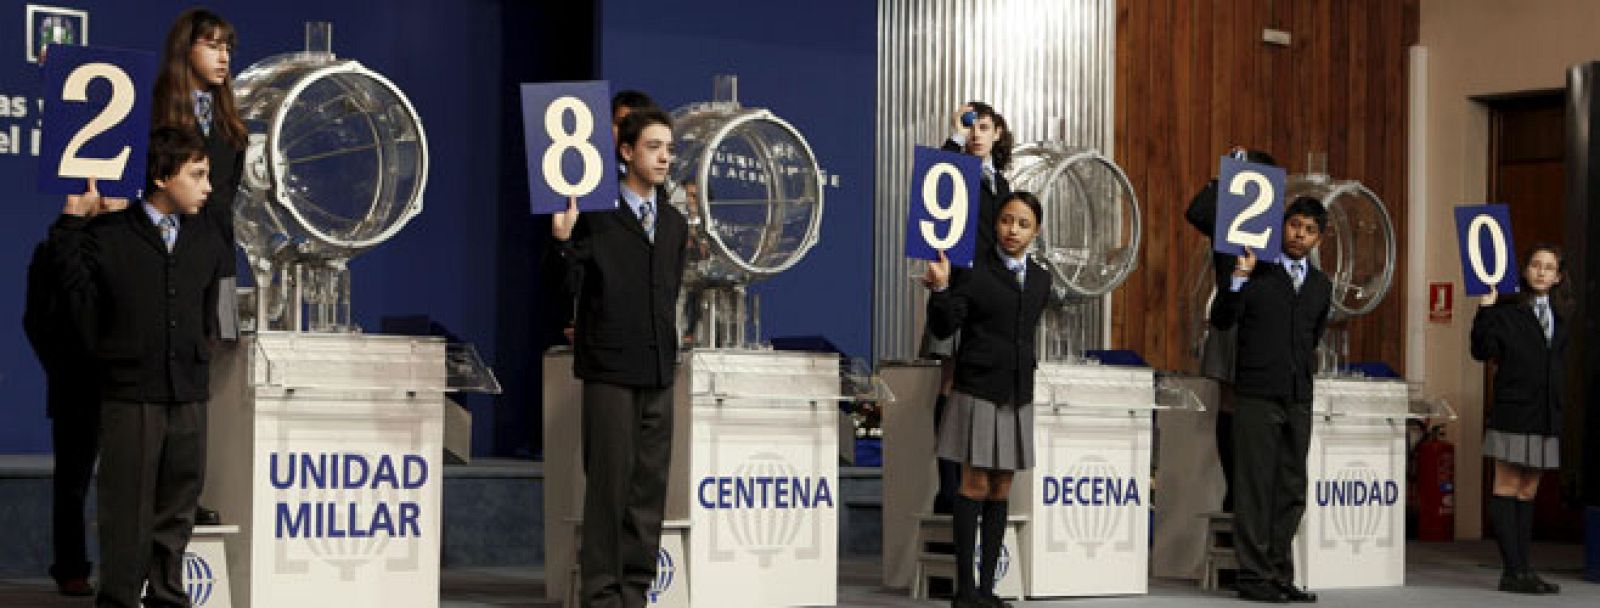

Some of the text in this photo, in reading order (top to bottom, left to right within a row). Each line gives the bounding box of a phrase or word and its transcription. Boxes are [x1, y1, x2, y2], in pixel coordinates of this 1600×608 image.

[58, 62, 135, 180] 2
[541, 96, 604, 197] 8
[919, 162, 969, 249] 9
[1226, 170, 1275, 249] 2
[1468, 213, 1508, 285] 0
[269, 453, 429, 490] UNIDAD
[697, 476, 833, 509] CENTENA
[1042, 476, 1141, 506] DECENA
[1315, 480, 1399, 506] UNIDAD
[275, 502, 421, 538] MILLAR
